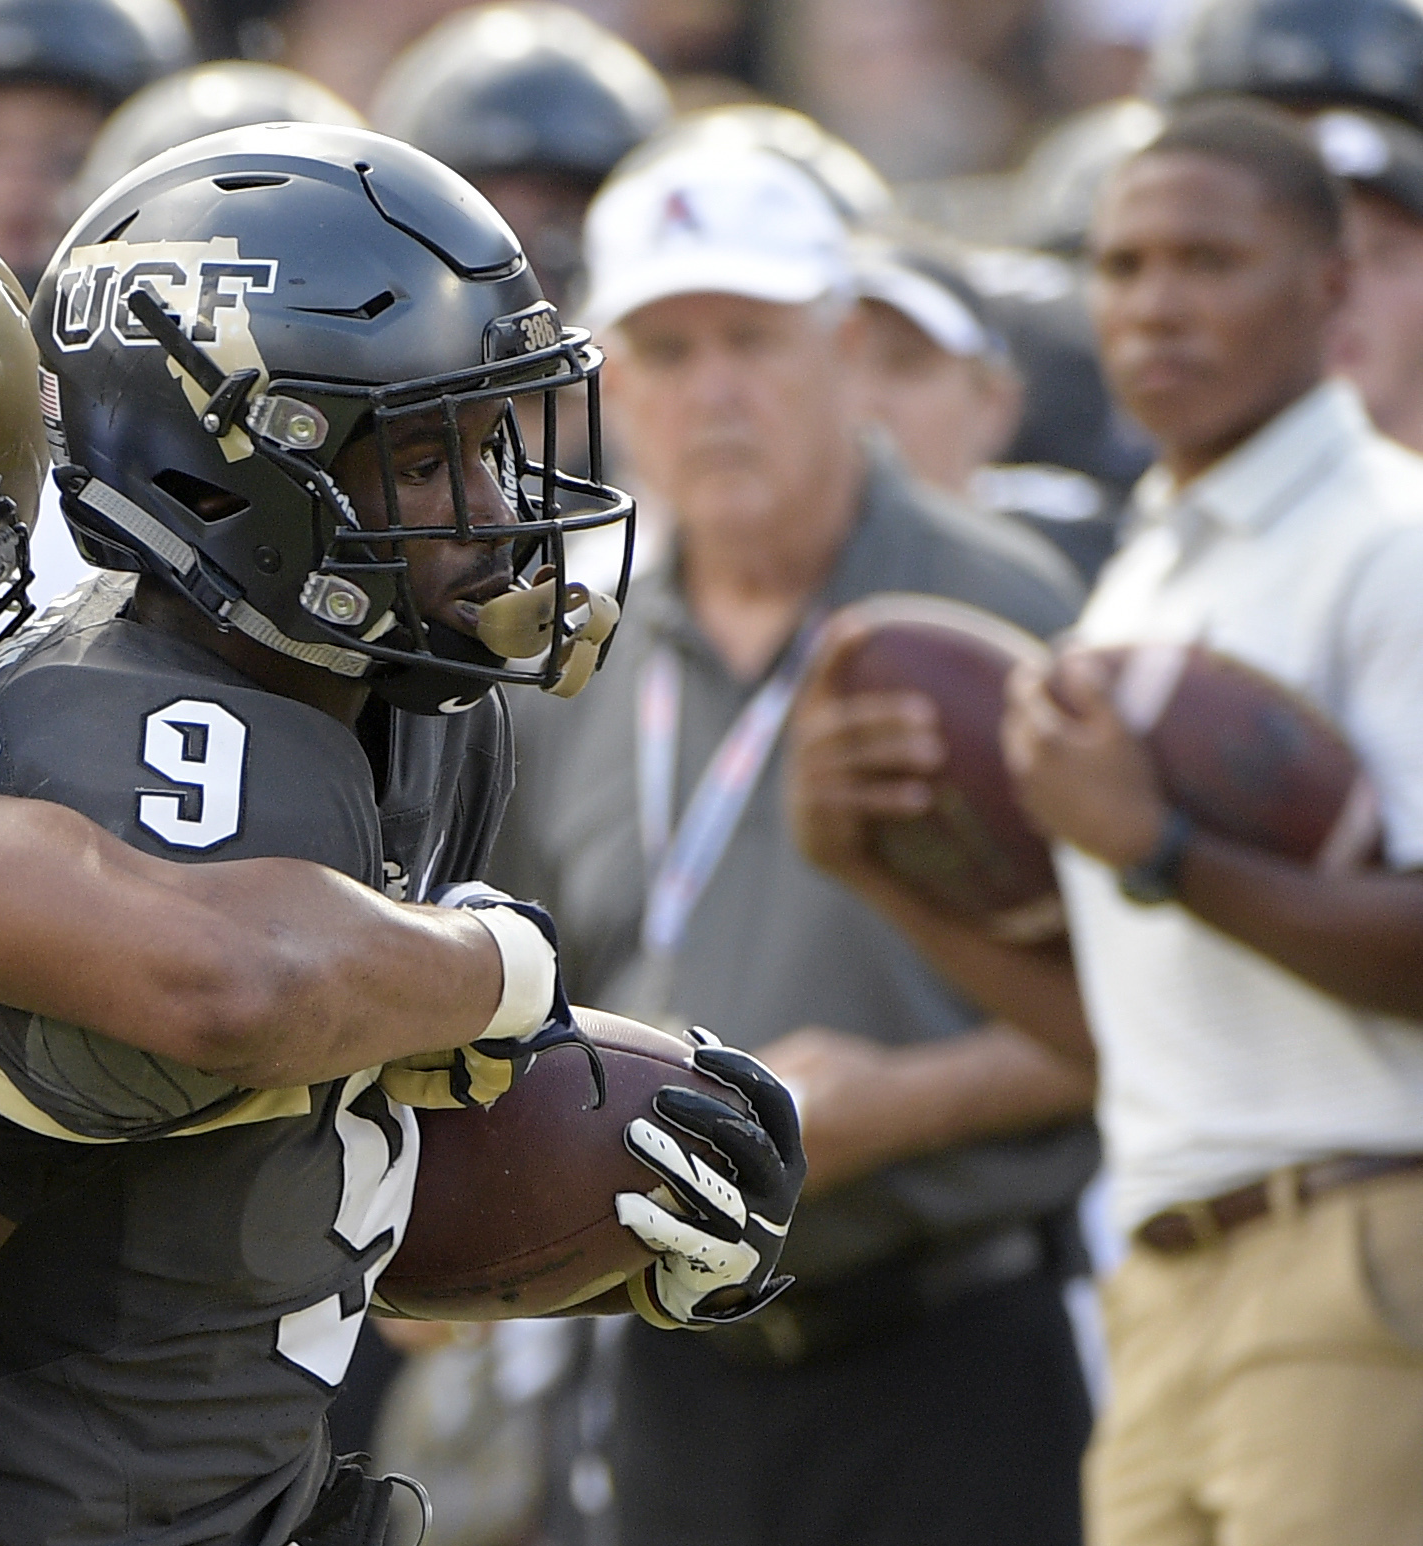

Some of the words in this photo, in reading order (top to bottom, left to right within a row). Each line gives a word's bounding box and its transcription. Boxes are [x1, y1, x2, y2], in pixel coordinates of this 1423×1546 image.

[52, 256, 279, 354] UCF
[520, 313, 555, 350] 386
[139, 699, 247, 848] 9
[275, 1064, 421, 1388] 9
